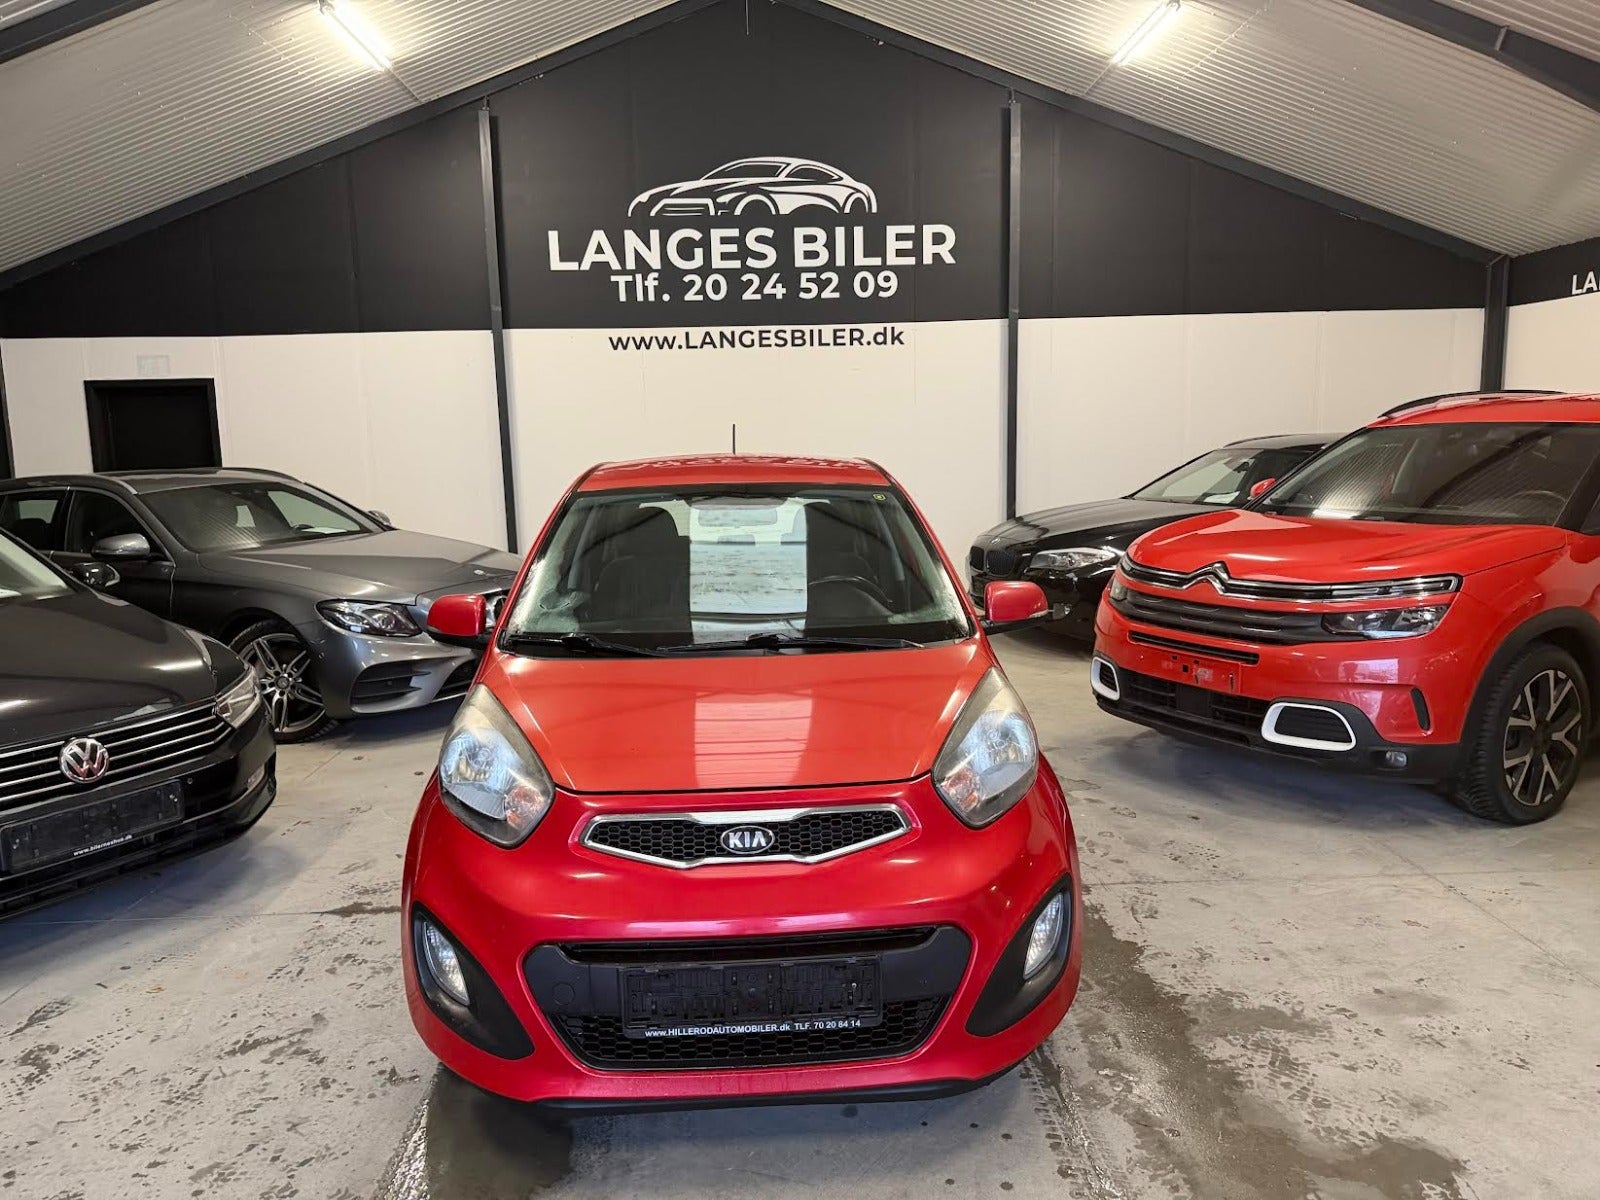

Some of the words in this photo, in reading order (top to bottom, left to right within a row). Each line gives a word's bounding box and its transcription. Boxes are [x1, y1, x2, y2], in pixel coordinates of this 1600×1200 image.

[547, 227, 779, 271] LANGES
[793, 224, 957, 268] BILER
[610, 273, 671, 302] Tlf.
[683, 274, 728, 302] 20
[740, 273, 787, 301] 24
[798, 271, 841, 300] 52
[853, 270, 899, 299] 09
[1572, 270, 1600, 295] LA
[608, 327, 905, 351] www.LANGESBILER.dk
[728, 831, 767, 848] KIA
[645, 1023, 791, 1037] www.HILLERODAUTOMOBILER.dk
[814, 1021, 824, 1030] 70
[825, 1020, 837, 1029] 20
[838, 1019, 849, 1029] 84
[850, 1018, 861, 1028] 14
